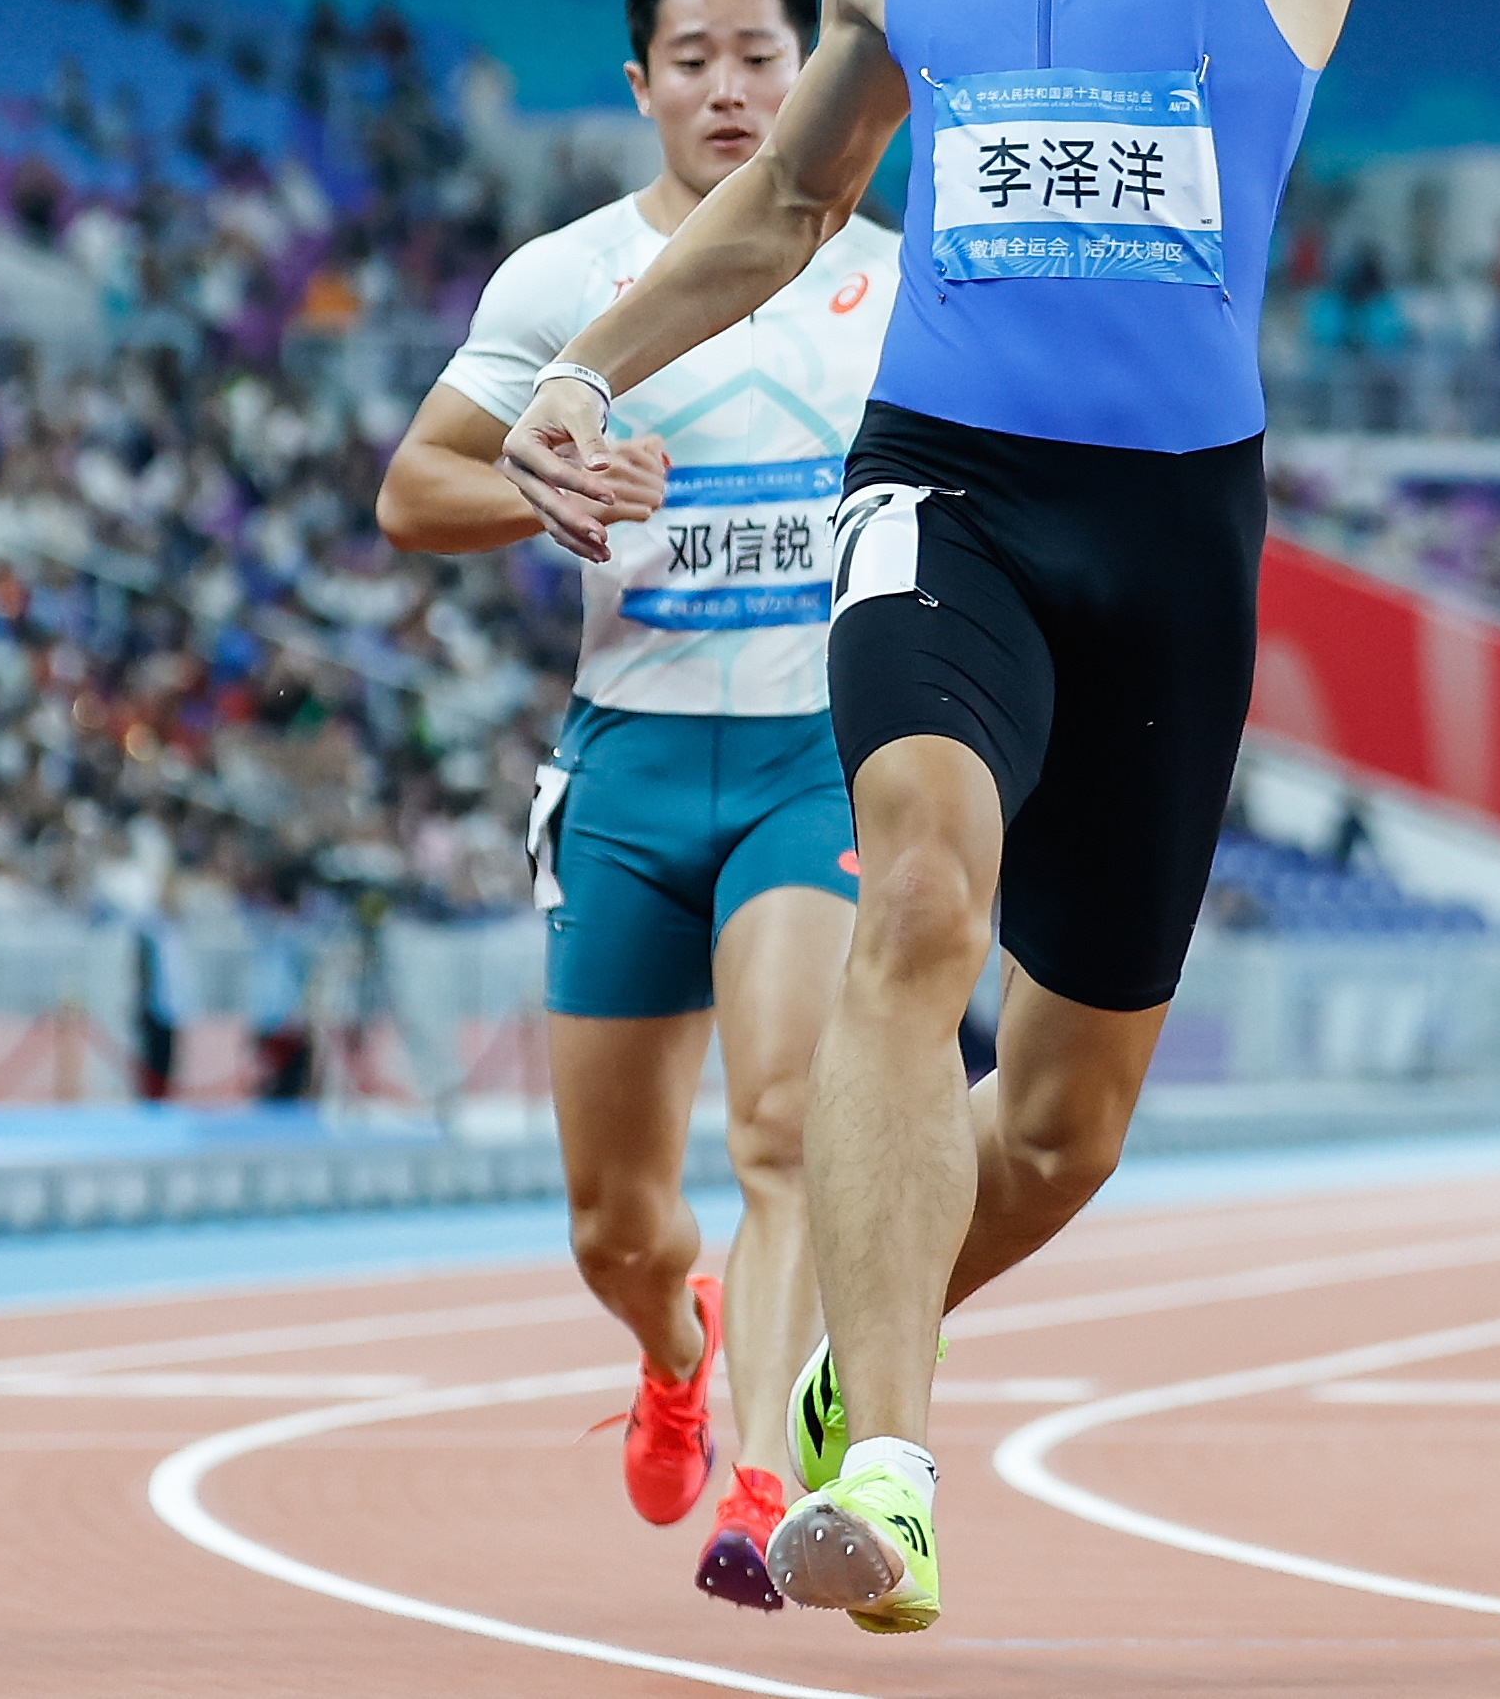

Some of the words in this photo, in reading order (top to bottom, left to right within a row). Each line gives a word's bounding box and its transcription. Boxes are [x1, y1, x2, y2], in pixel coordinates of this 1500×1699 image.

[976, 86, 1153, 104] 中华人民共和国第十五届运动会
[978, 137, 1166, 211] 李泽洋
[666, 514, 814, 577] 邓信锐
